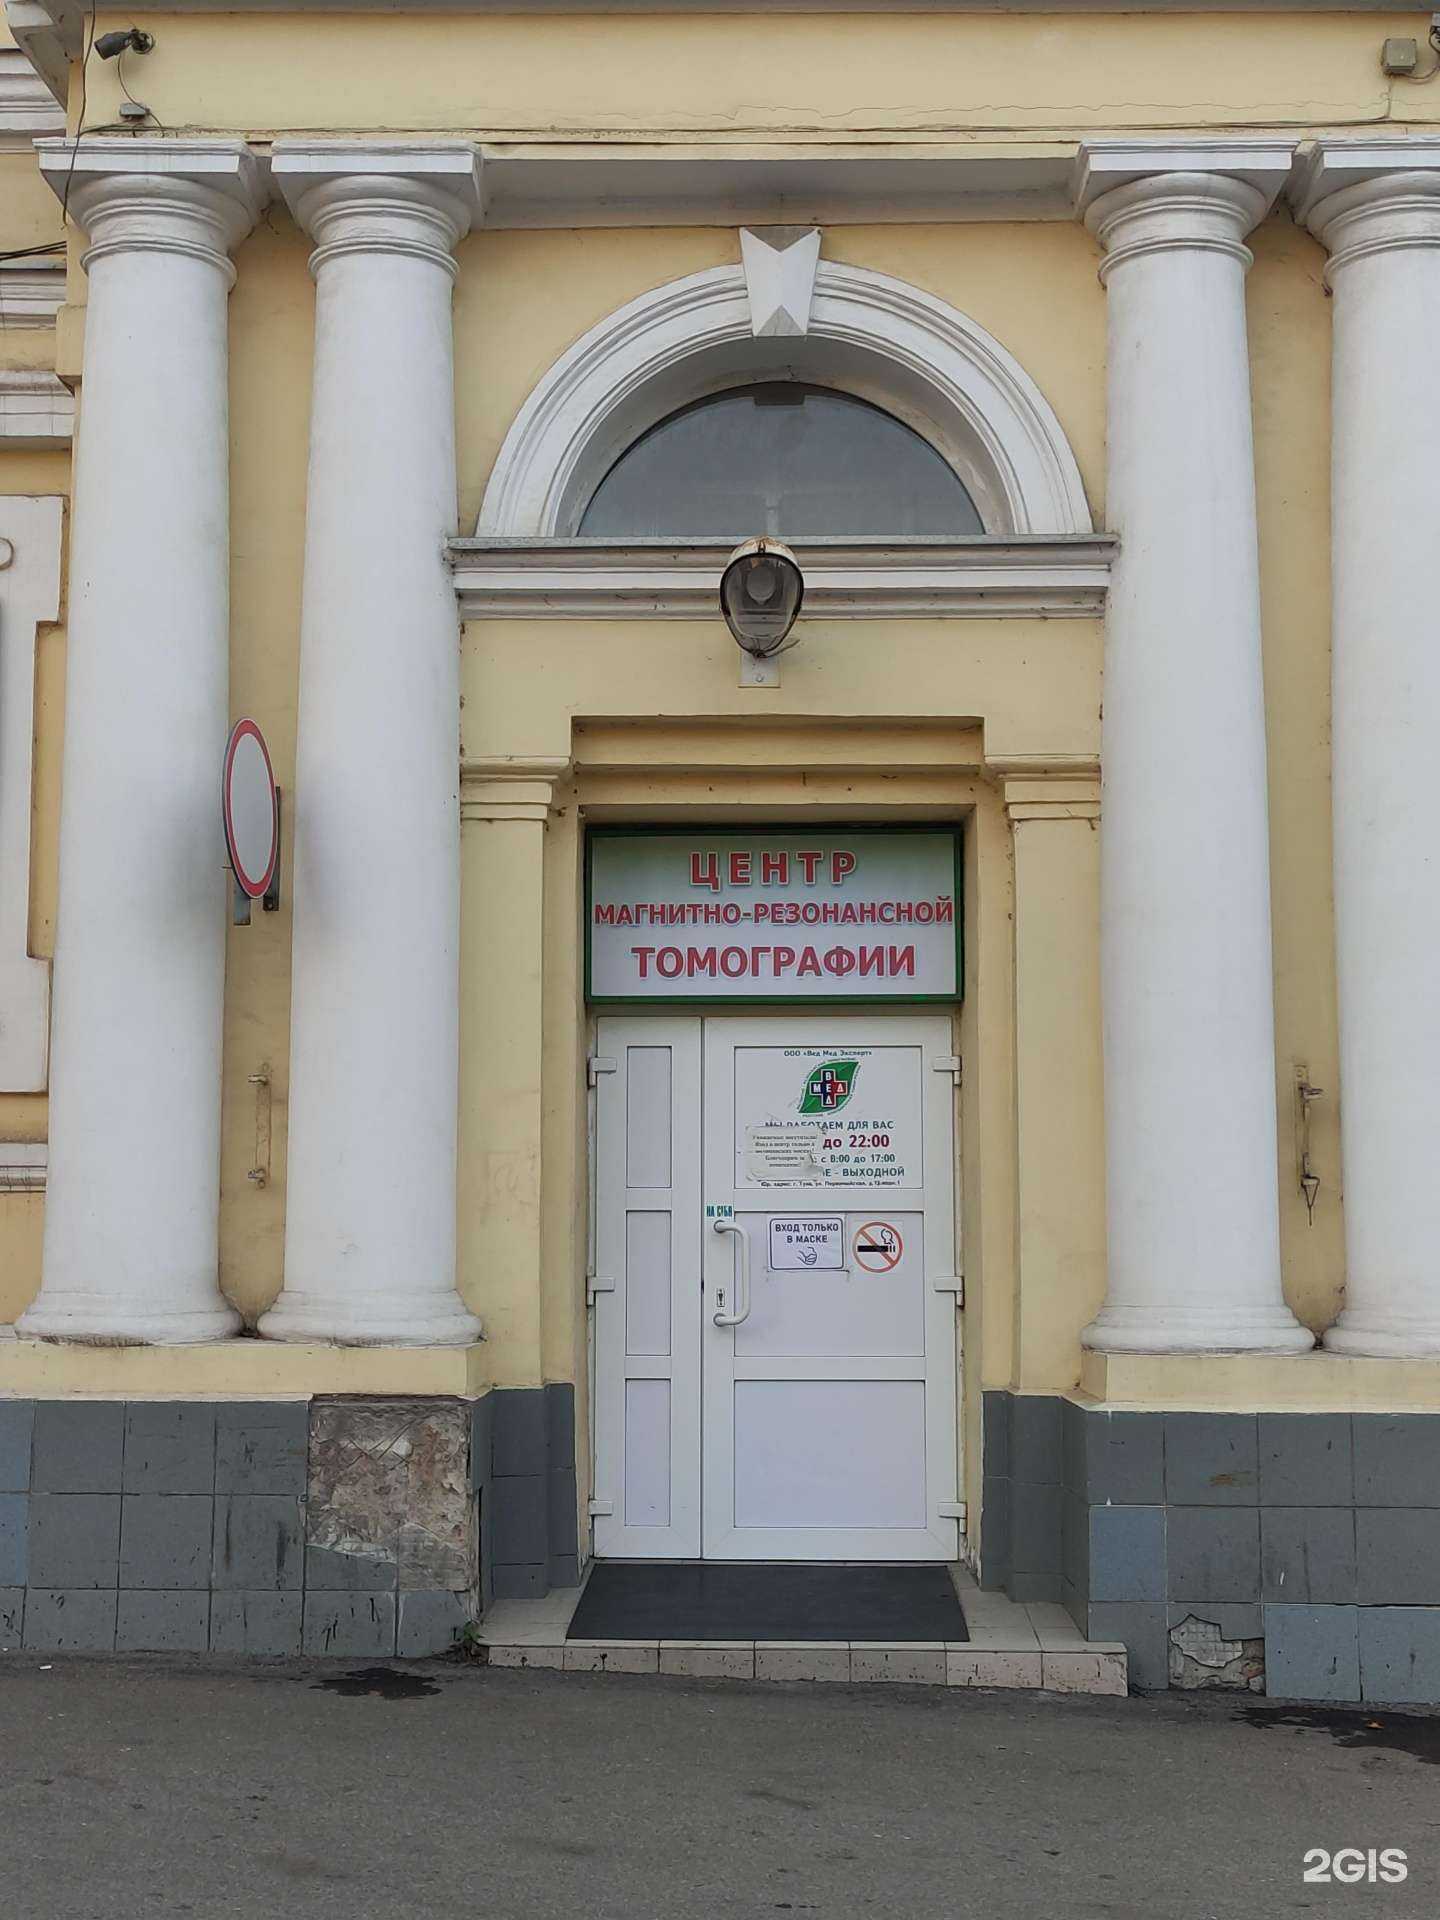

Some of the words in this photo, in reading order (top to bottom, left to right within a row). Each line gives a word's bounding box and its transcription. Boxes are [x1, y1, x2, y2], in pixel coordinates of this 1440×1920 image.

[689, 851, 857, 893] ЦЕНТР
[594, 895, 953, 926] МАГНИТНО-РЕЗОНАНСНОЙ
[630, 945, 916, 978] ТОМОГРАФИИ
[847, 1121, 868, 1130] ДЛЯ
[873, 1121, 894, 1129] ВАС
[823, 1138, 842, 1150] до
[849, 1134, 889, 1148] 22:00
[830, 1154, 850, 1163] 8:00
[871, 1153, 895, 1162] 17:00
[842, 1166, 905, 1178] ВЫХОДНОЙ
[706, 1205, 715, 1217] НА
[775, 1223, 800, 1232] ВХОД
[802, 1223, 839, 1232] ТОЛЬКО
[787, 1235, 793, 1243] В
[796, 1235, 828, 1243] МАСКЕ
